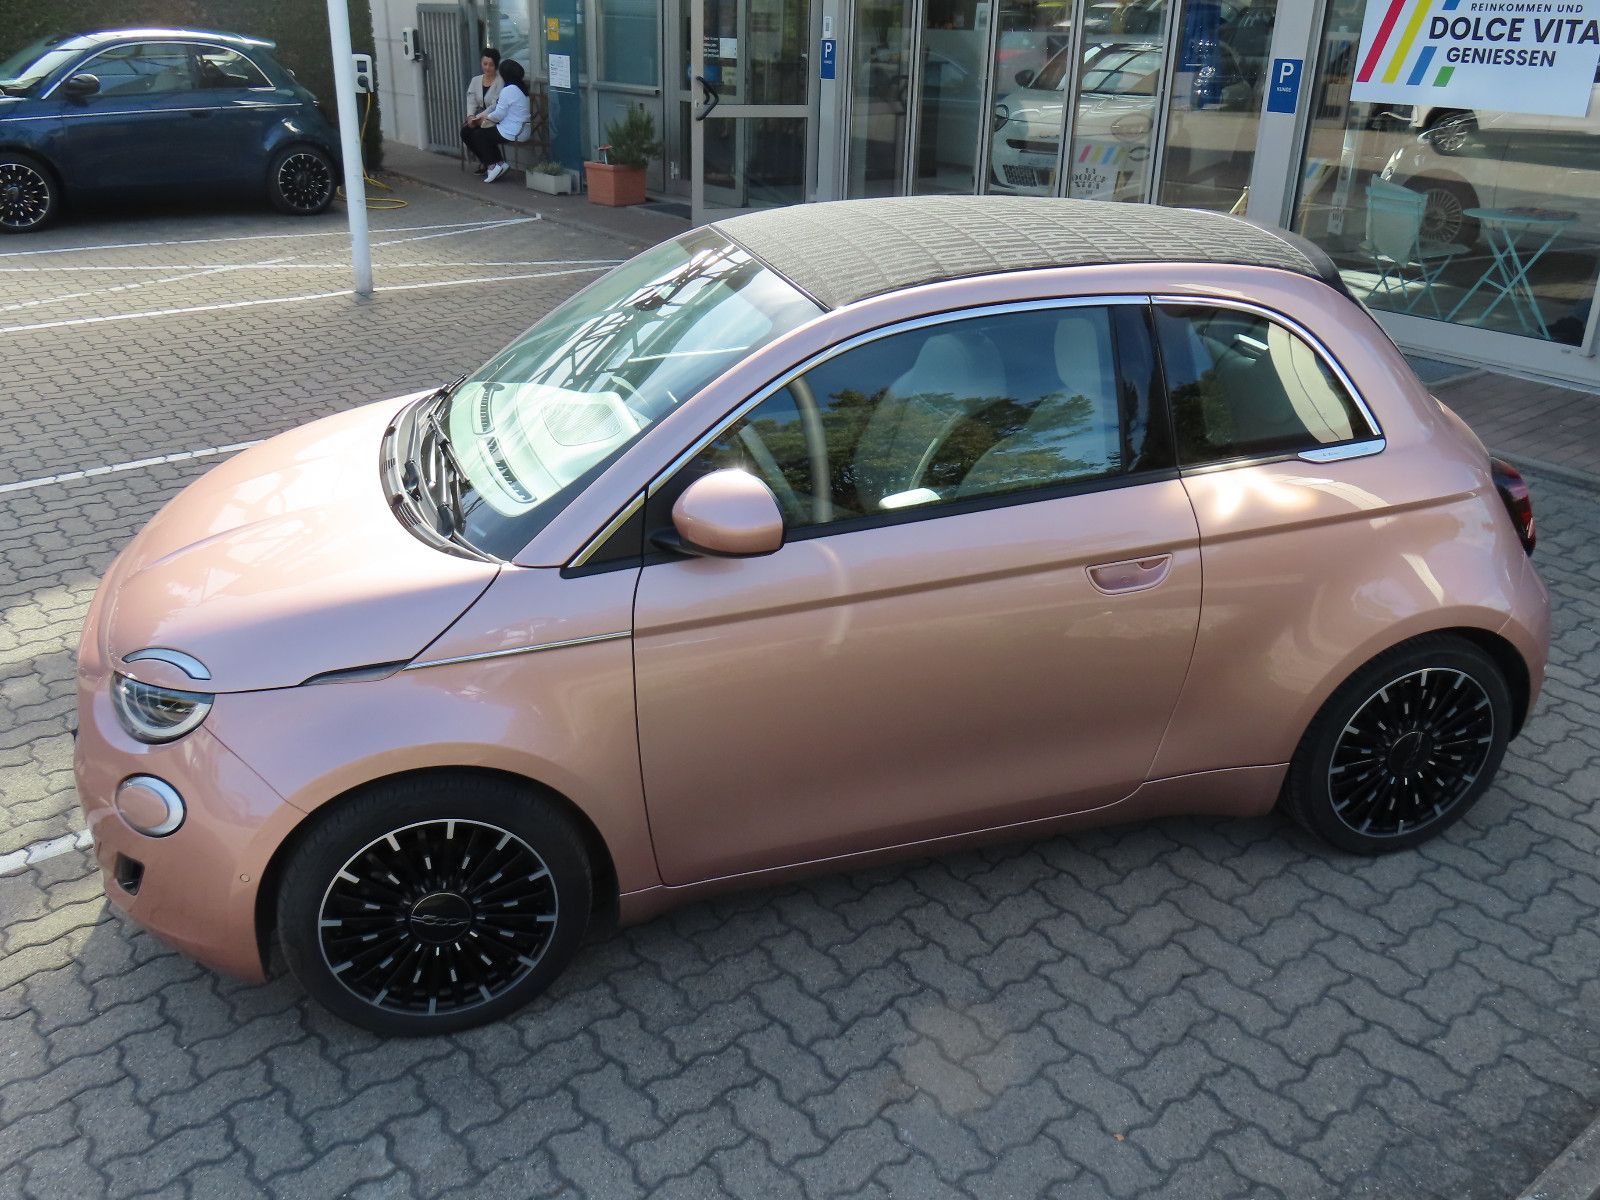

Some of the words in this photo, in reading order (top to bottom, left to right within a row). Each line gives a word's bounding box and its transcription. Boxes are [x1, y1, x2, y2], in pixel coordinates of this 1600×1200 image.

[1470, 2, 1552, 13] REINKOMMEN
[1557, 4, 1584, 14] UND
[1429, 16, 1525, 42] DOLCE
[1533, 18, 1600, 45] VITA
[825, 42, 833, 58] P
[1446, 46, 1557, 67] GENIESSEN
[1279, 62, 1294, 84] P
